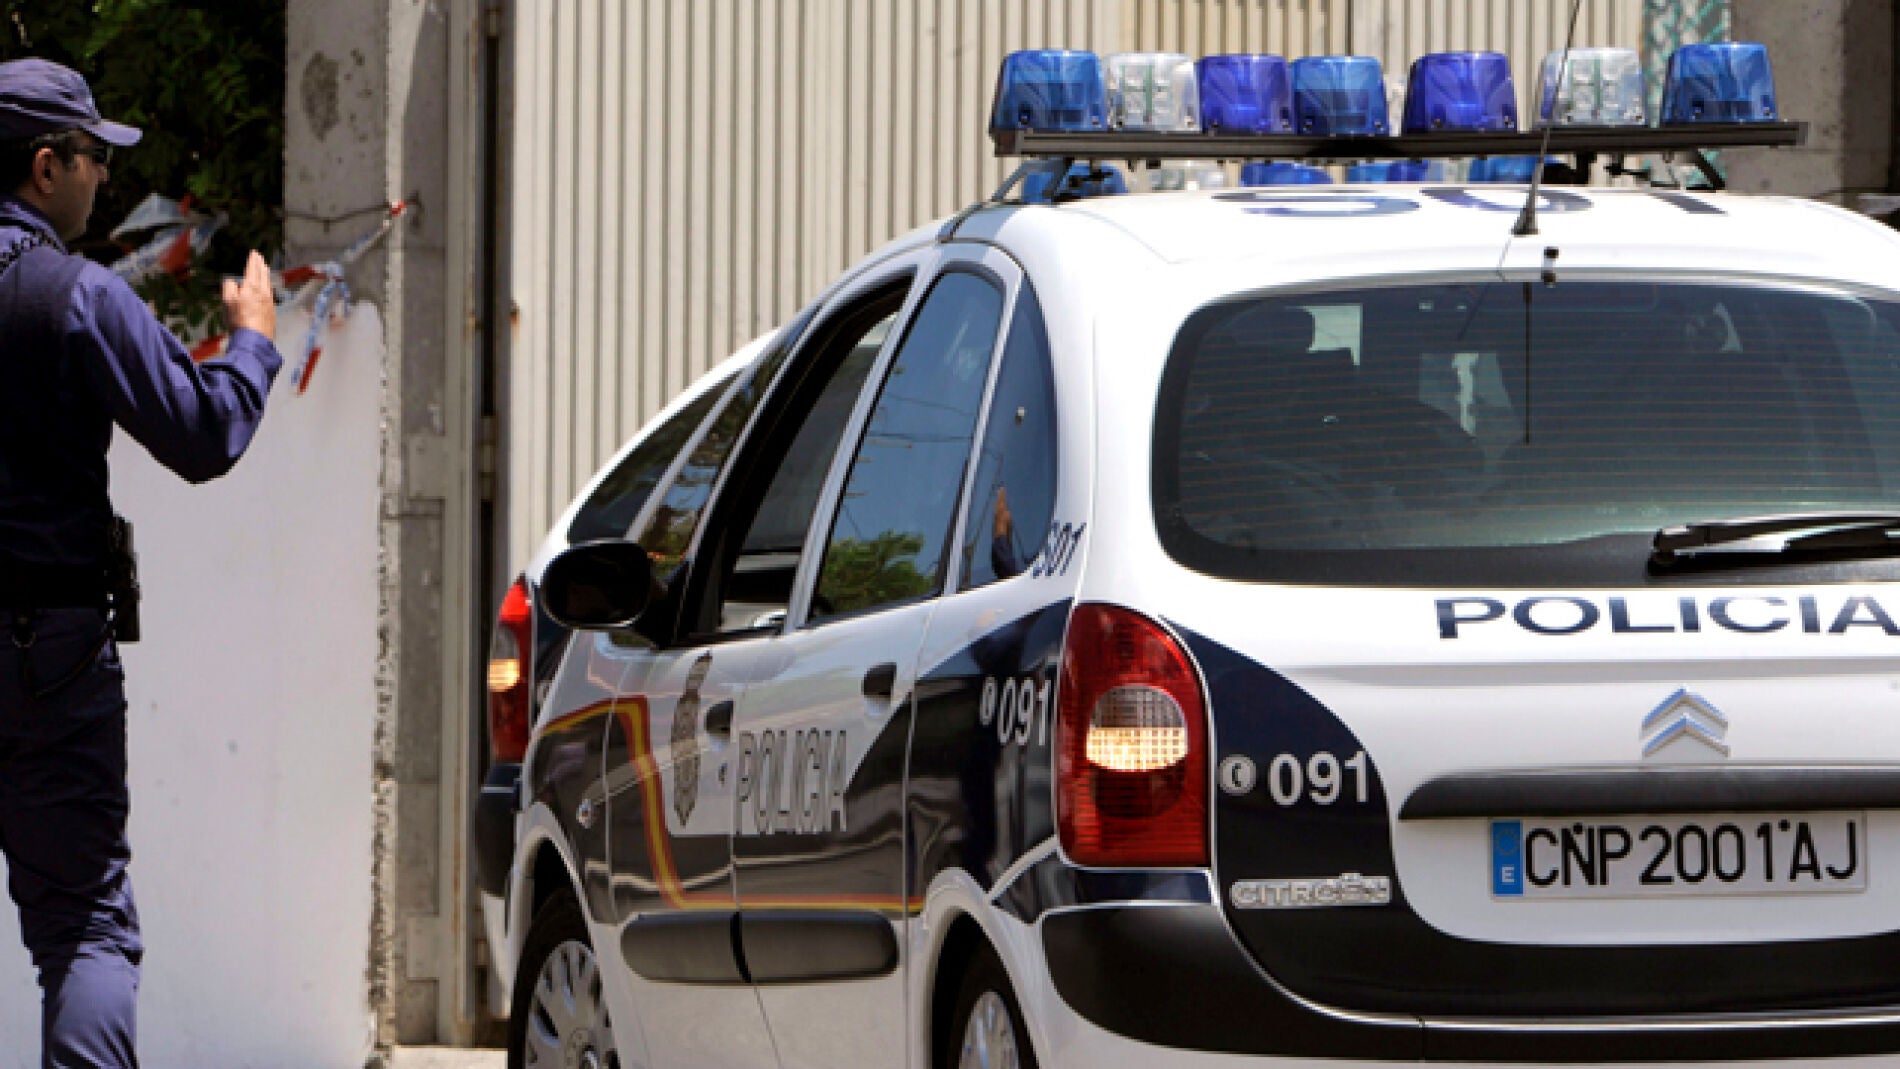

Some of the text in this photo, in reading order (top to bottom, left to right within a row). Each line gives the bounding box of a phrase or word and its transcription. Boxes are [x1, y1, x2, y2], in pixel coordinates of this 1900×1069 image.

[1435, 596, 1900, 638] POLICIA
[998, 676, 1051, 746] 091
[736, 726, 848, 836] POLICIA
[1269, 751, 1369, 805] 091
[1501, 866, 1515, 883] E
